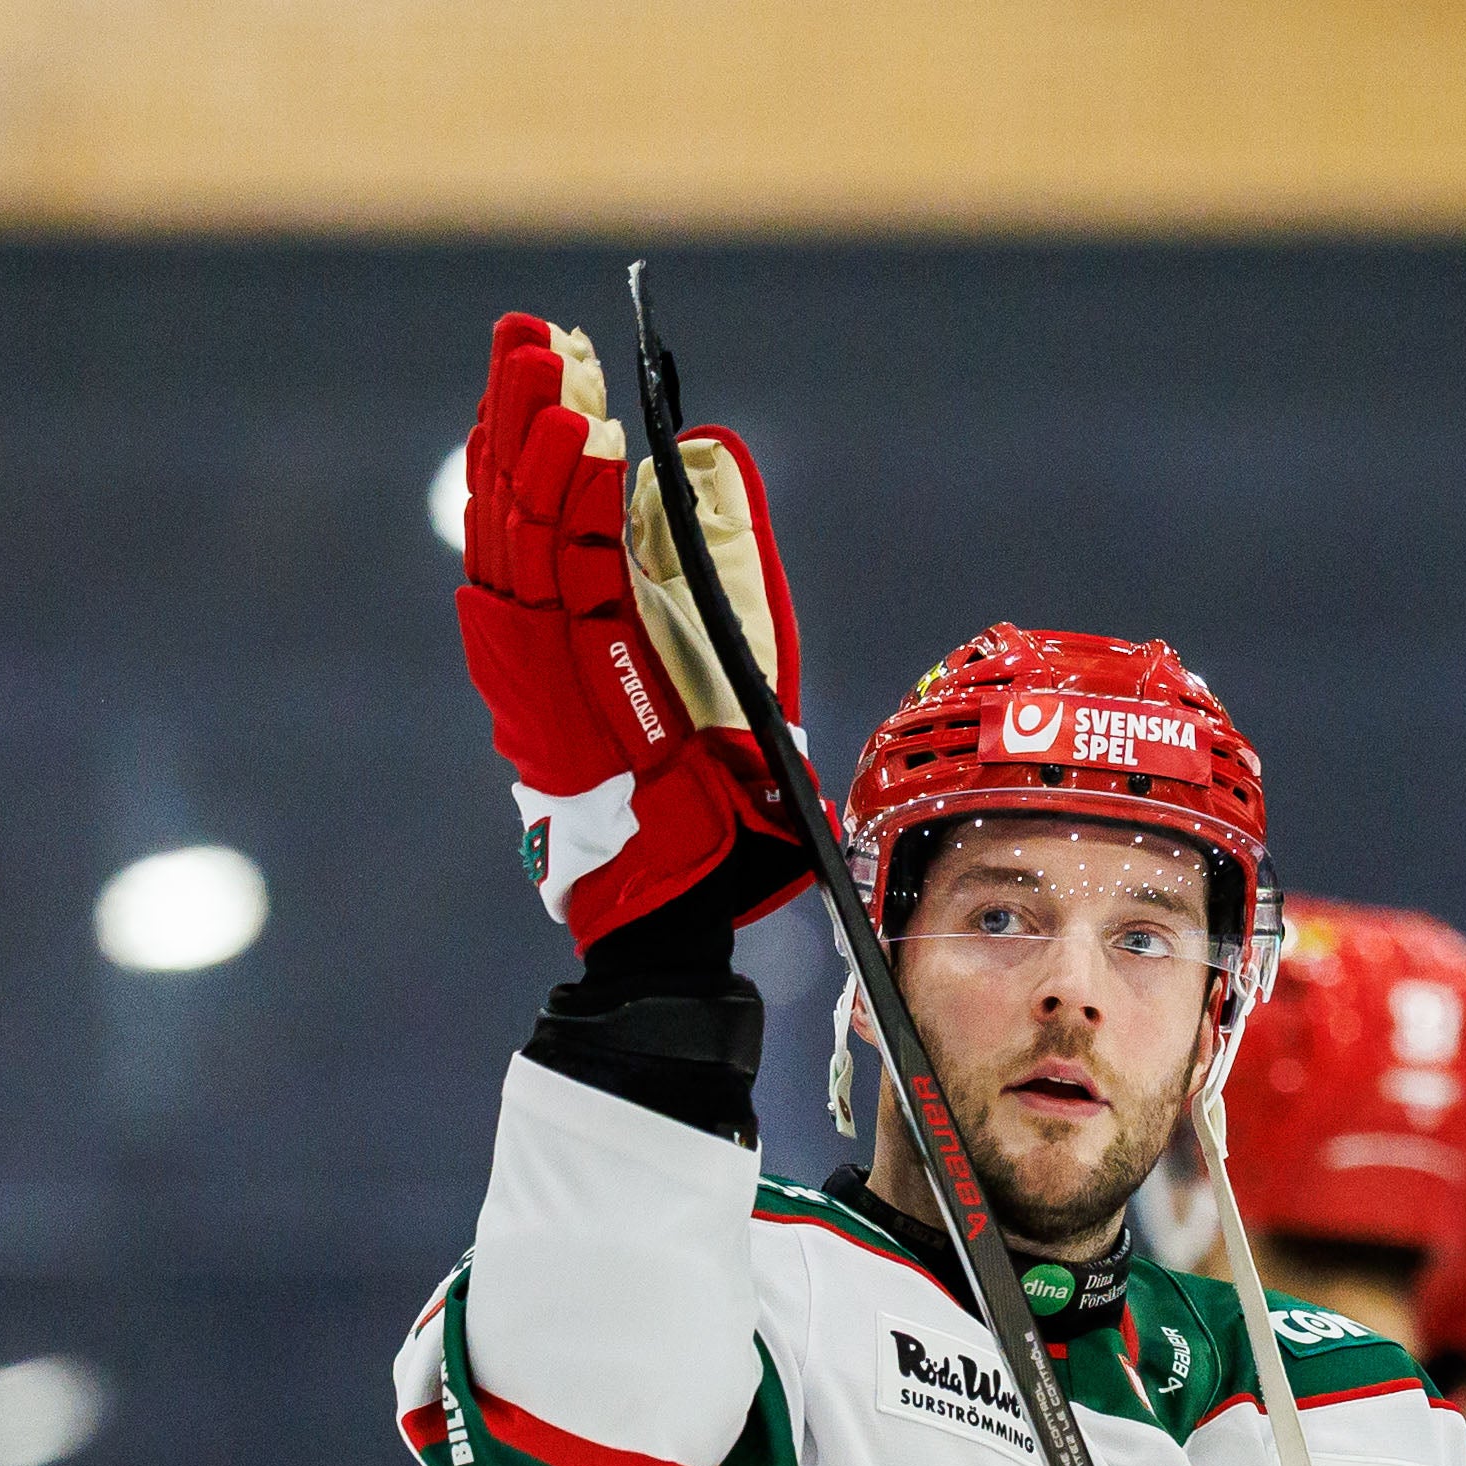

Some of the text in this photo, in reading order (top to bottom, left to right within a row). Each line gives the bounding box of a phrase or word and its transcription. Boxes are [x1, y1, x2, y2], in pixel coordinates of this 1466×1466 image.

[610, 641, 666, 744] RUNDBLAD
[1072, 733, 1139, 766] SPEL
[1074, 707, 1197, 751] SVENSKA
[1023, 1279, 1068, 1299] dina
[1085, 1273, 1114, 1290] Dina
[890, 1330, 1025, 1419] Röda Ulve
[1160, 1326, 1191, 1379] BAUER
[900, 1388, 1034, 1453] SURSTRÖMMING
[1035, 1382, 1064, 1448] CONTROL
[1056, 1409, 1071, 1432] LE
